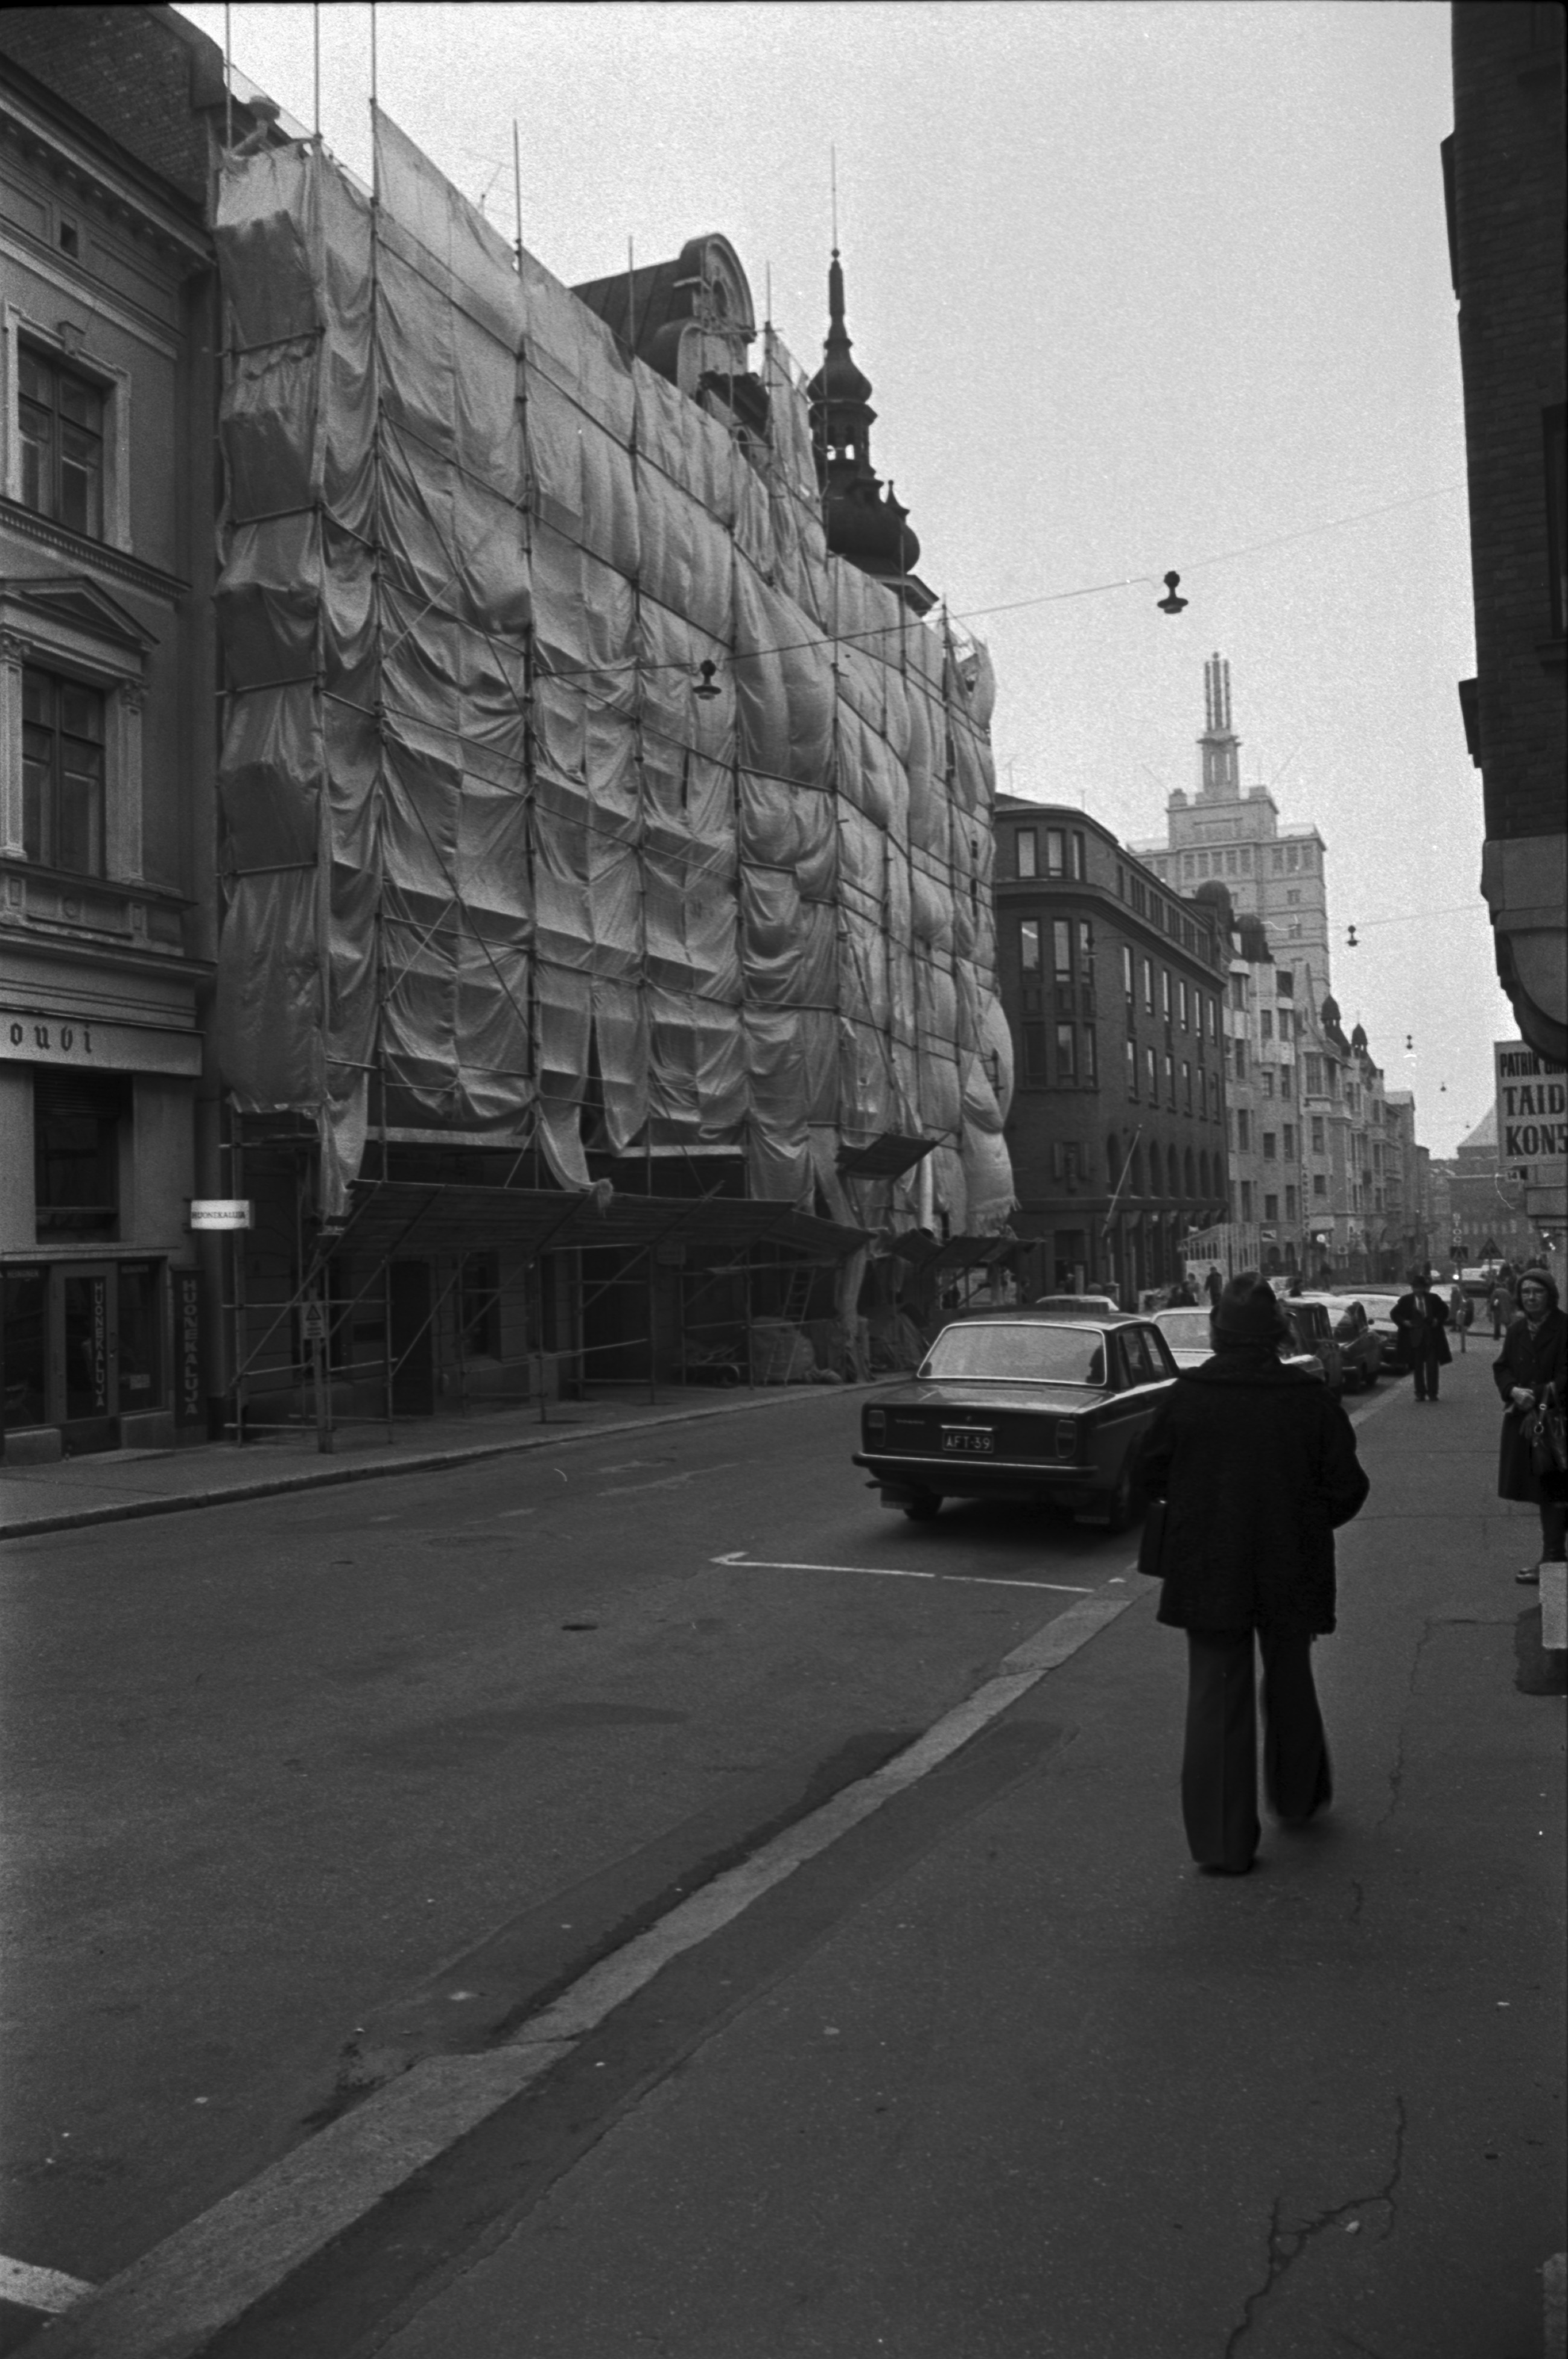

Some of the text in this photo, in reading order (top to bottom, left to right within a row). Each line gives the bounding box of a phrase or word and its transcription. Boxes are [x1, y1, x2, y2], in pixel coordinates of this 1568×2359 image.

[1500, 1051, 1540, 1077] PATRIK
[1503, 1084, 1564, 1116] TAID
[94, 1282, 104, 1407] HUONEKALUJA
[182, 1280, 198, 1416] HUONEKALUJA
[946, 1436, 991, 1450] AFT-39
